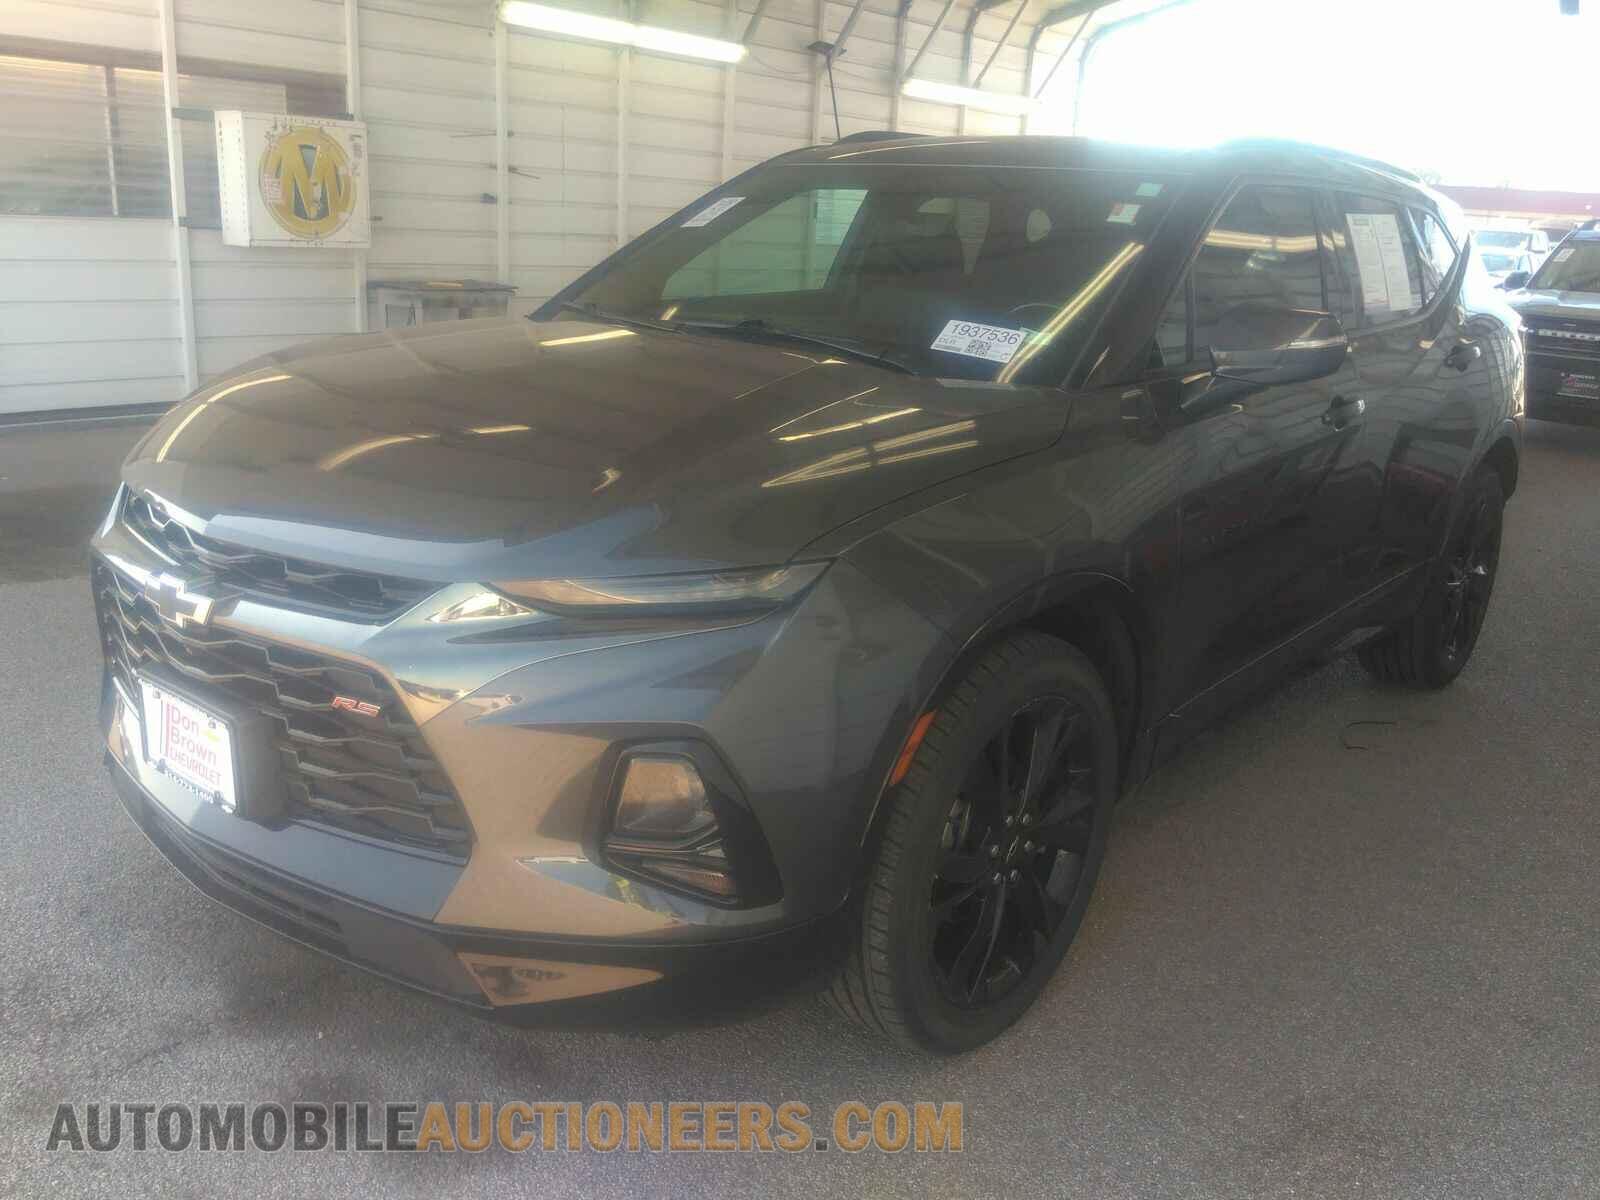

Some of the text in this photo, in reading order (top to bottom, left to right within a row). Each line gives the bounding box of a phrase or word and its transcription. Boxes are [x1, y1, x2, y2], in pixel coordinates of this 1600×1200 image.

[951, 323, 1021, 345] 1937536
[331, 696, 380, 717] RS
[171, 705, 200, 737] Don
[171, 726, 217, 765] Brown
